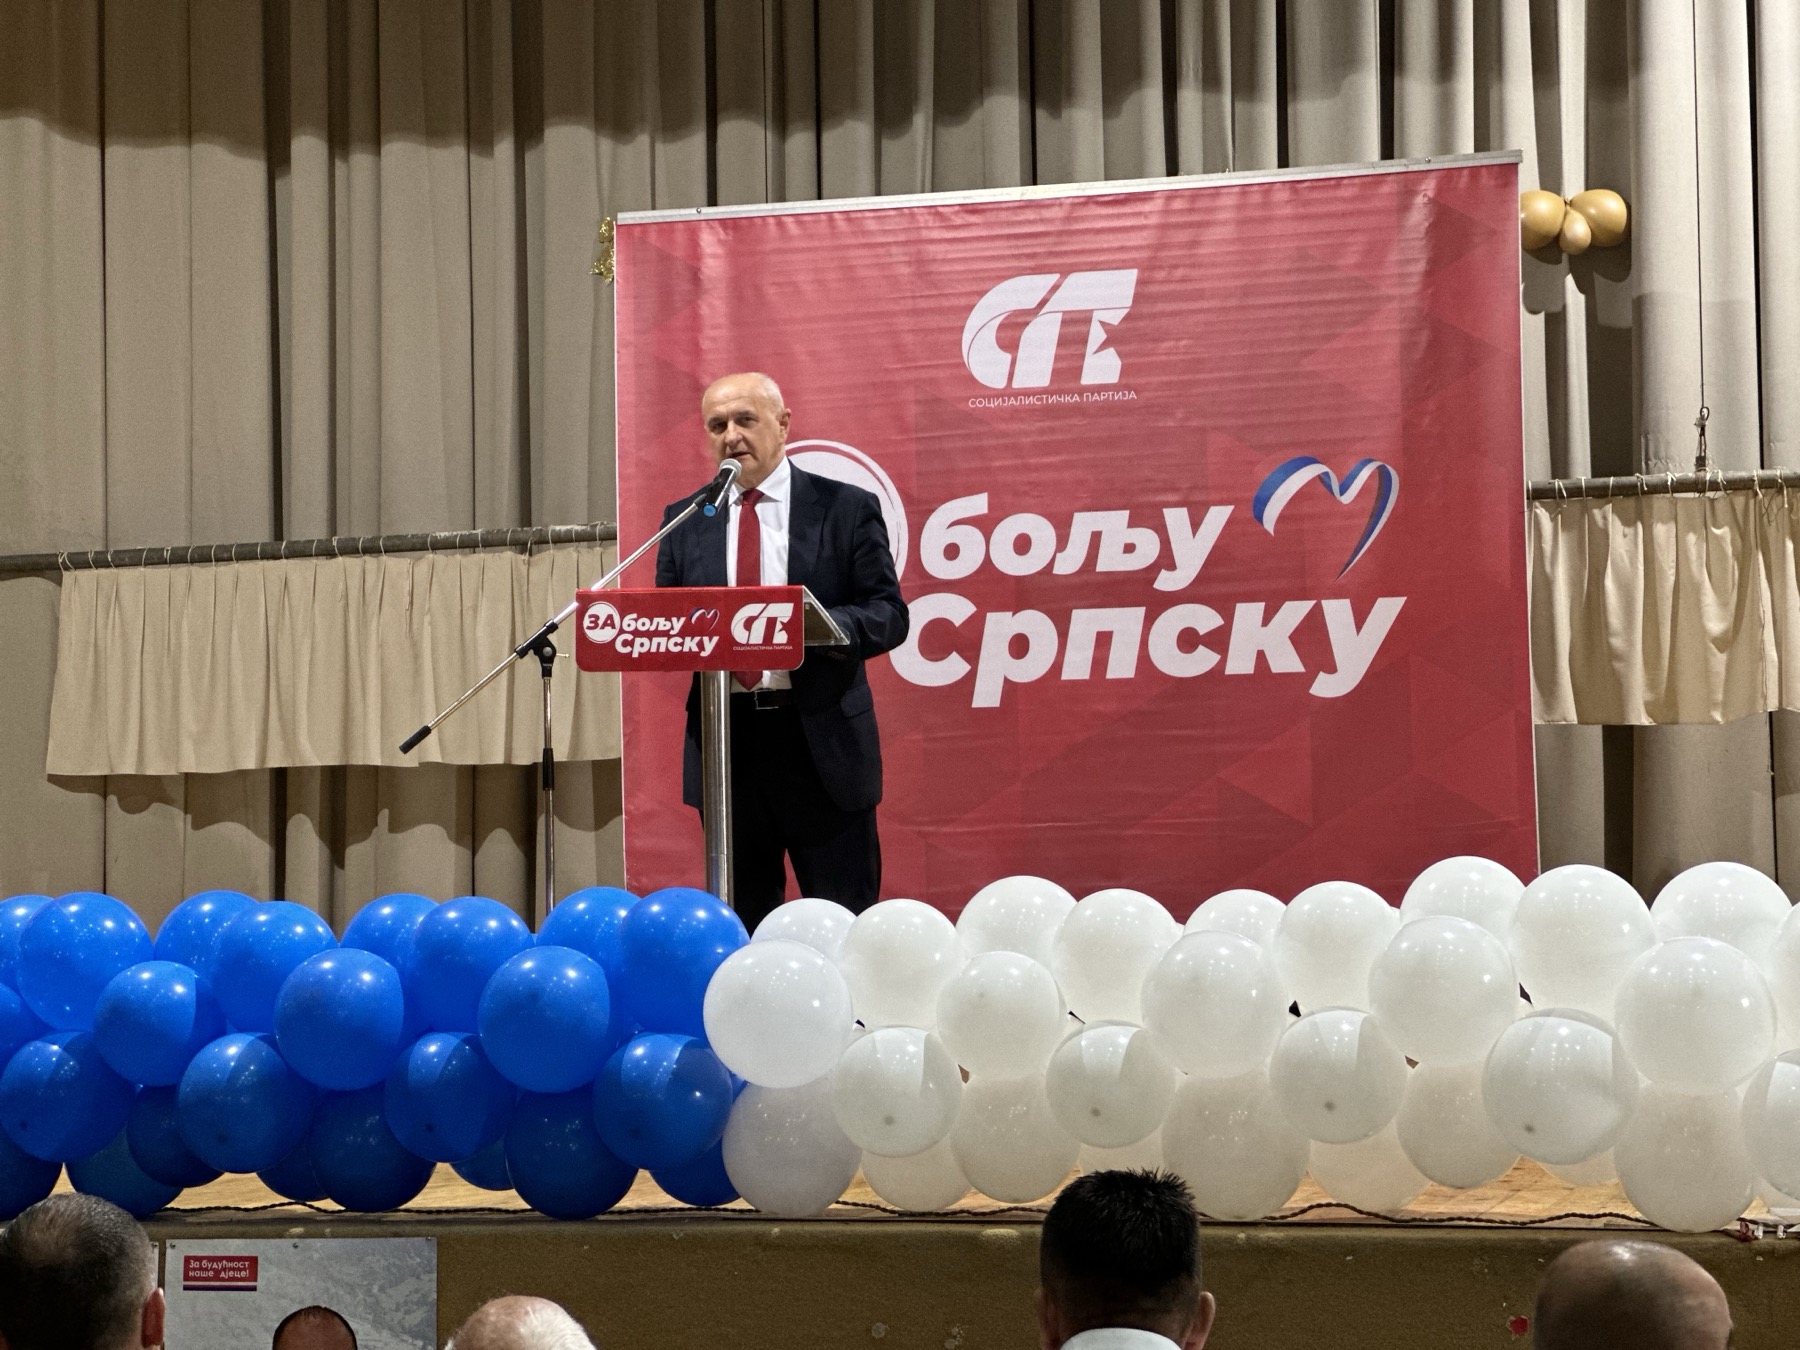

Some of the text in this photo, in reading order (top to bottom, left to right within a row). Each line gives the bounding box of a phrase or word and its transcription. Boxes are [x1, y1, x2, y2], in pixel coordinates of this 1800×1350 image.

[968, 390, 1137, 408] СОЦИЈАЛИСТИЧКА ПАРТИЈА
[920, 492, 1235, 592] бољу
[585, 613, 686, 635] ЗА бољу
[615, 634, 720, 657] Српску
[889, 592, 1407, 708] Српску
[189, 1259, 250, 1270] За будућност
[219, 1269, 249, 1279] дјеце!
